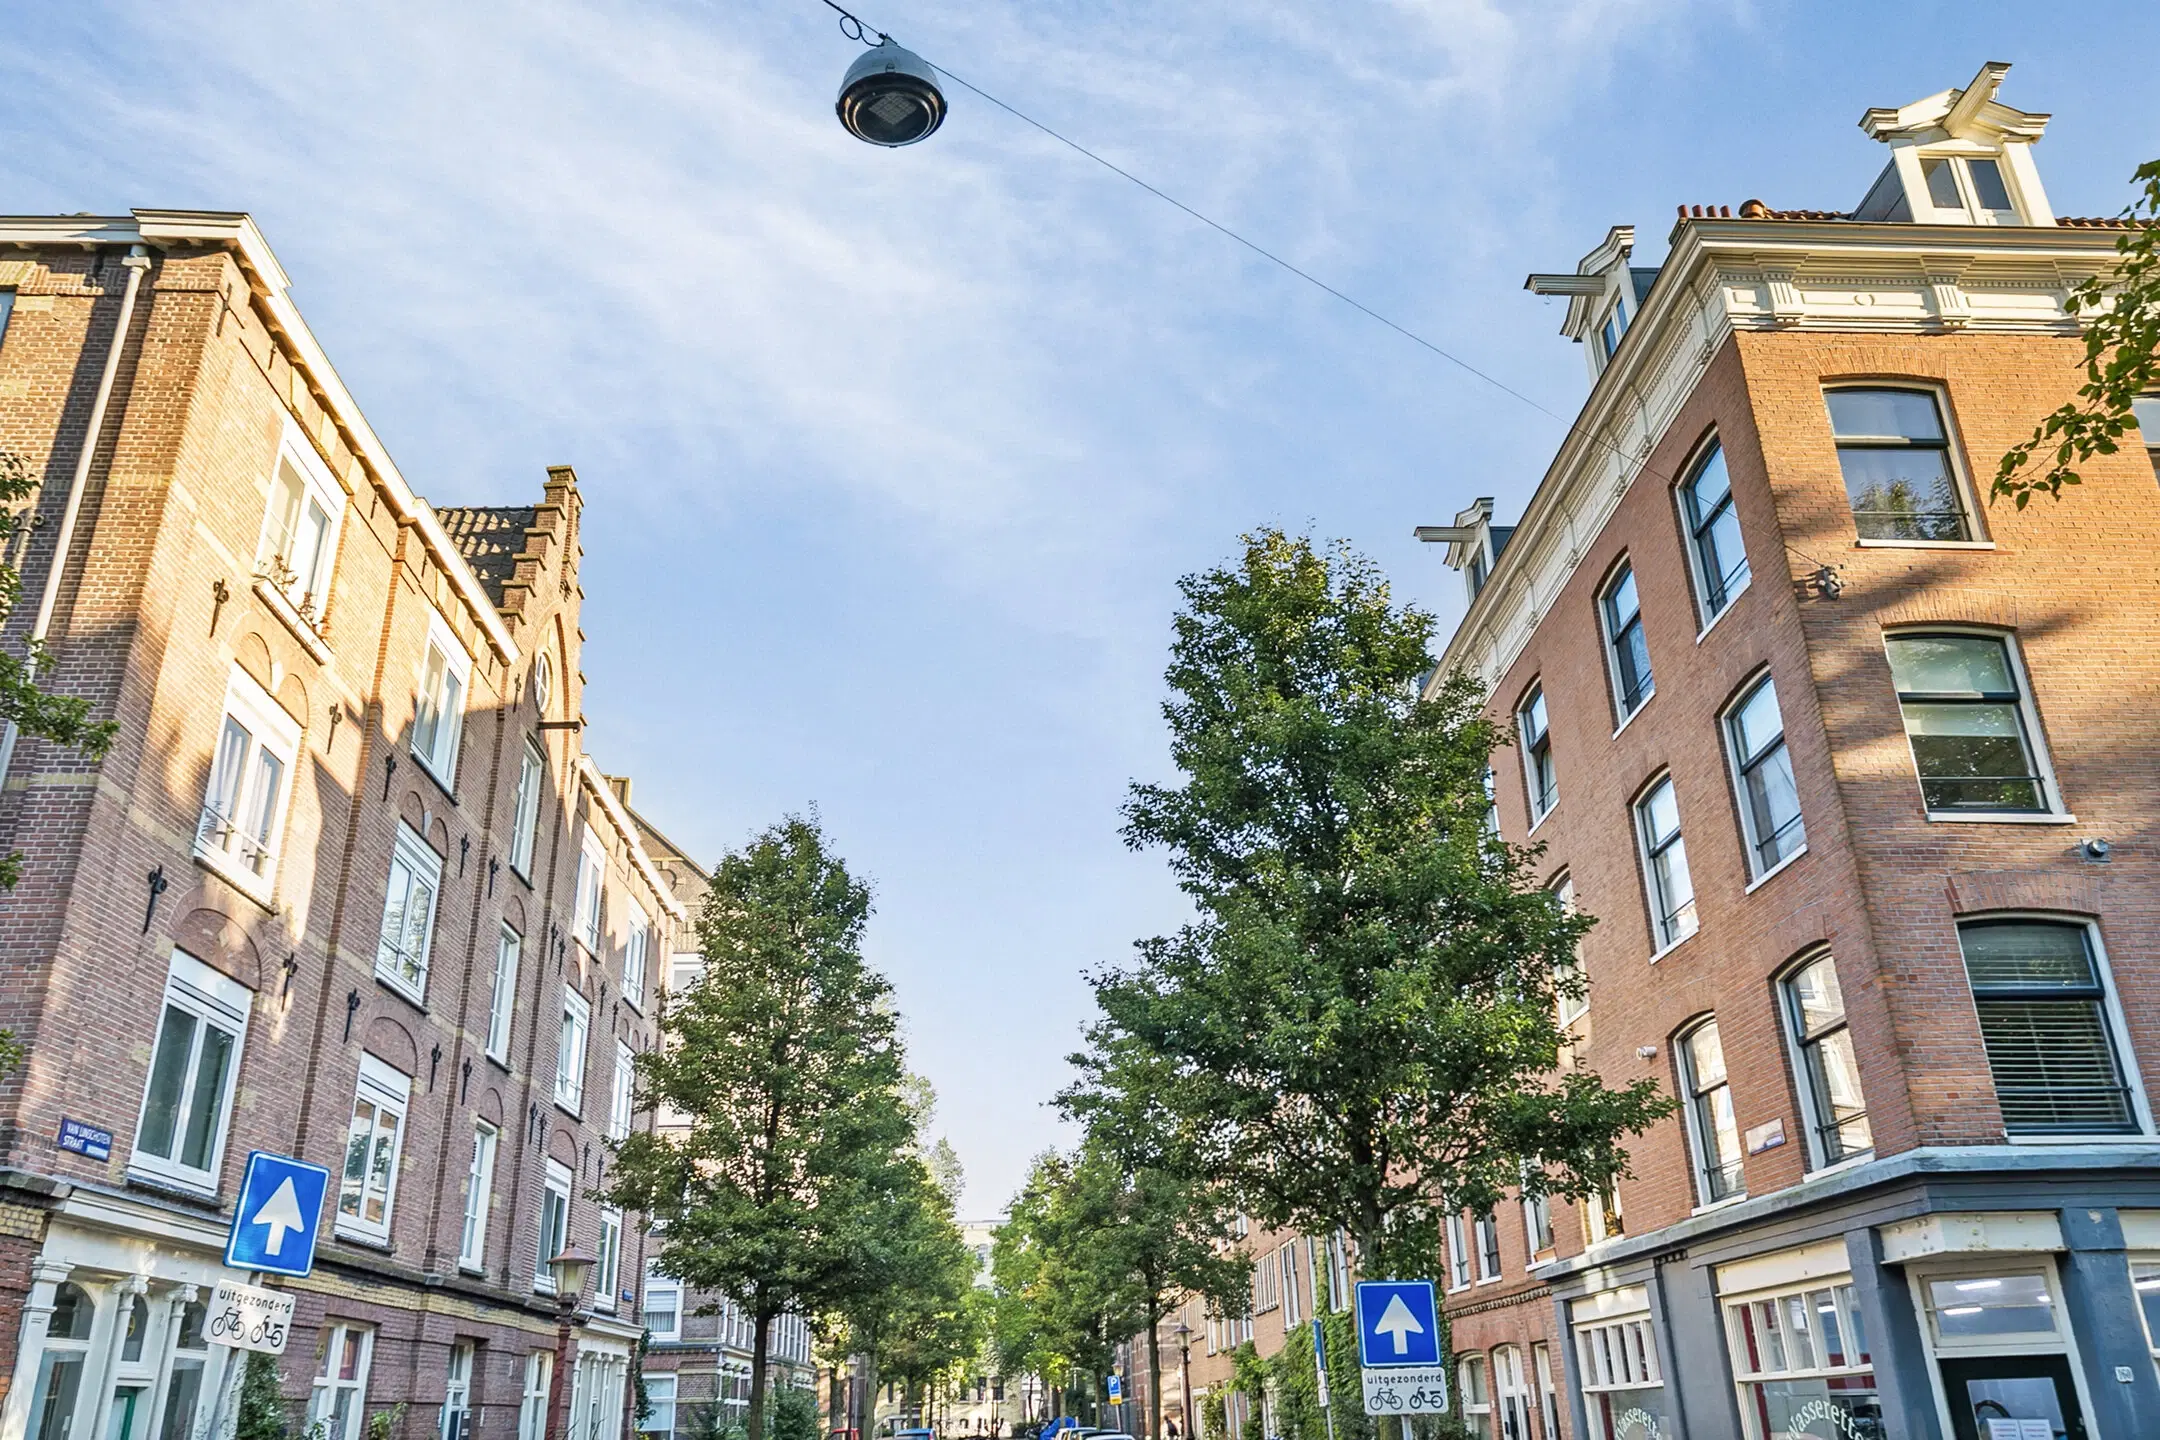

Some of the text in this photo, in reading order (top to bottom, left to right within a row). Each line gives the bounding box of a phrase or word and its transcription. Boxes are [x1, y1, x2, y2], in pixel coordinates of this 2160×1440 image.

[66, 1122, 80, 1136] VAN
[62, 1135, 85, 1150] STRAAT
[219, 1288, 292, 1314] uitgezonderd
[1366, 1373, 1442, 1386] uitgezonderd
